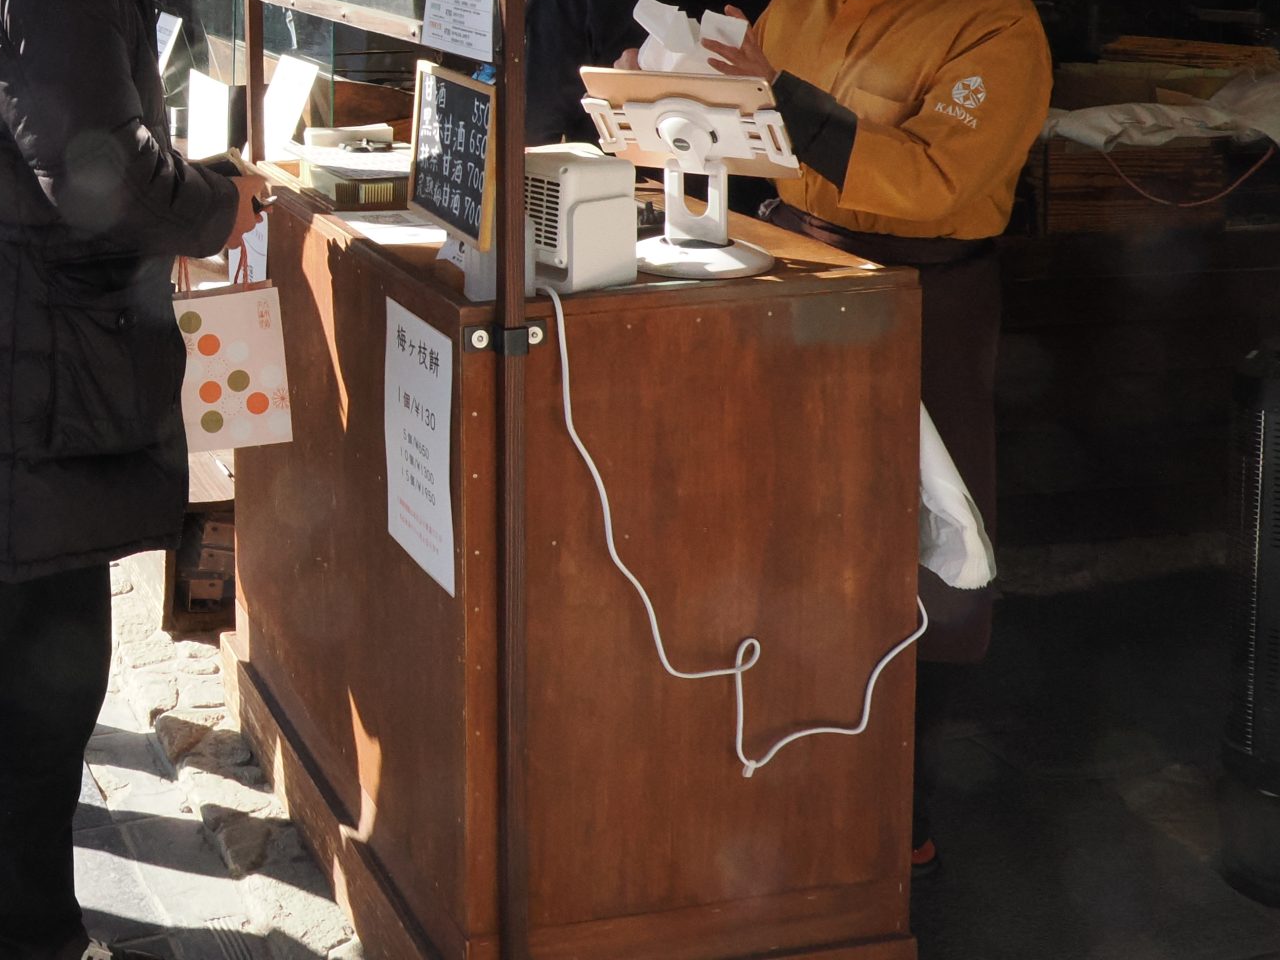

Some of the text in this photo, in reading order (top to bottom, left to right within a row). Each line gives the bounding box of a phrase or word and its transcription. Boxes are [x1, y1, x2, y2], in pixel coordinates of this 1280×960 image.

[424, 75, 447, 108] 甘酒
[466, 161, 485, 193] 700
[396, 323, 440, 379] 梅ヶ枝餅
